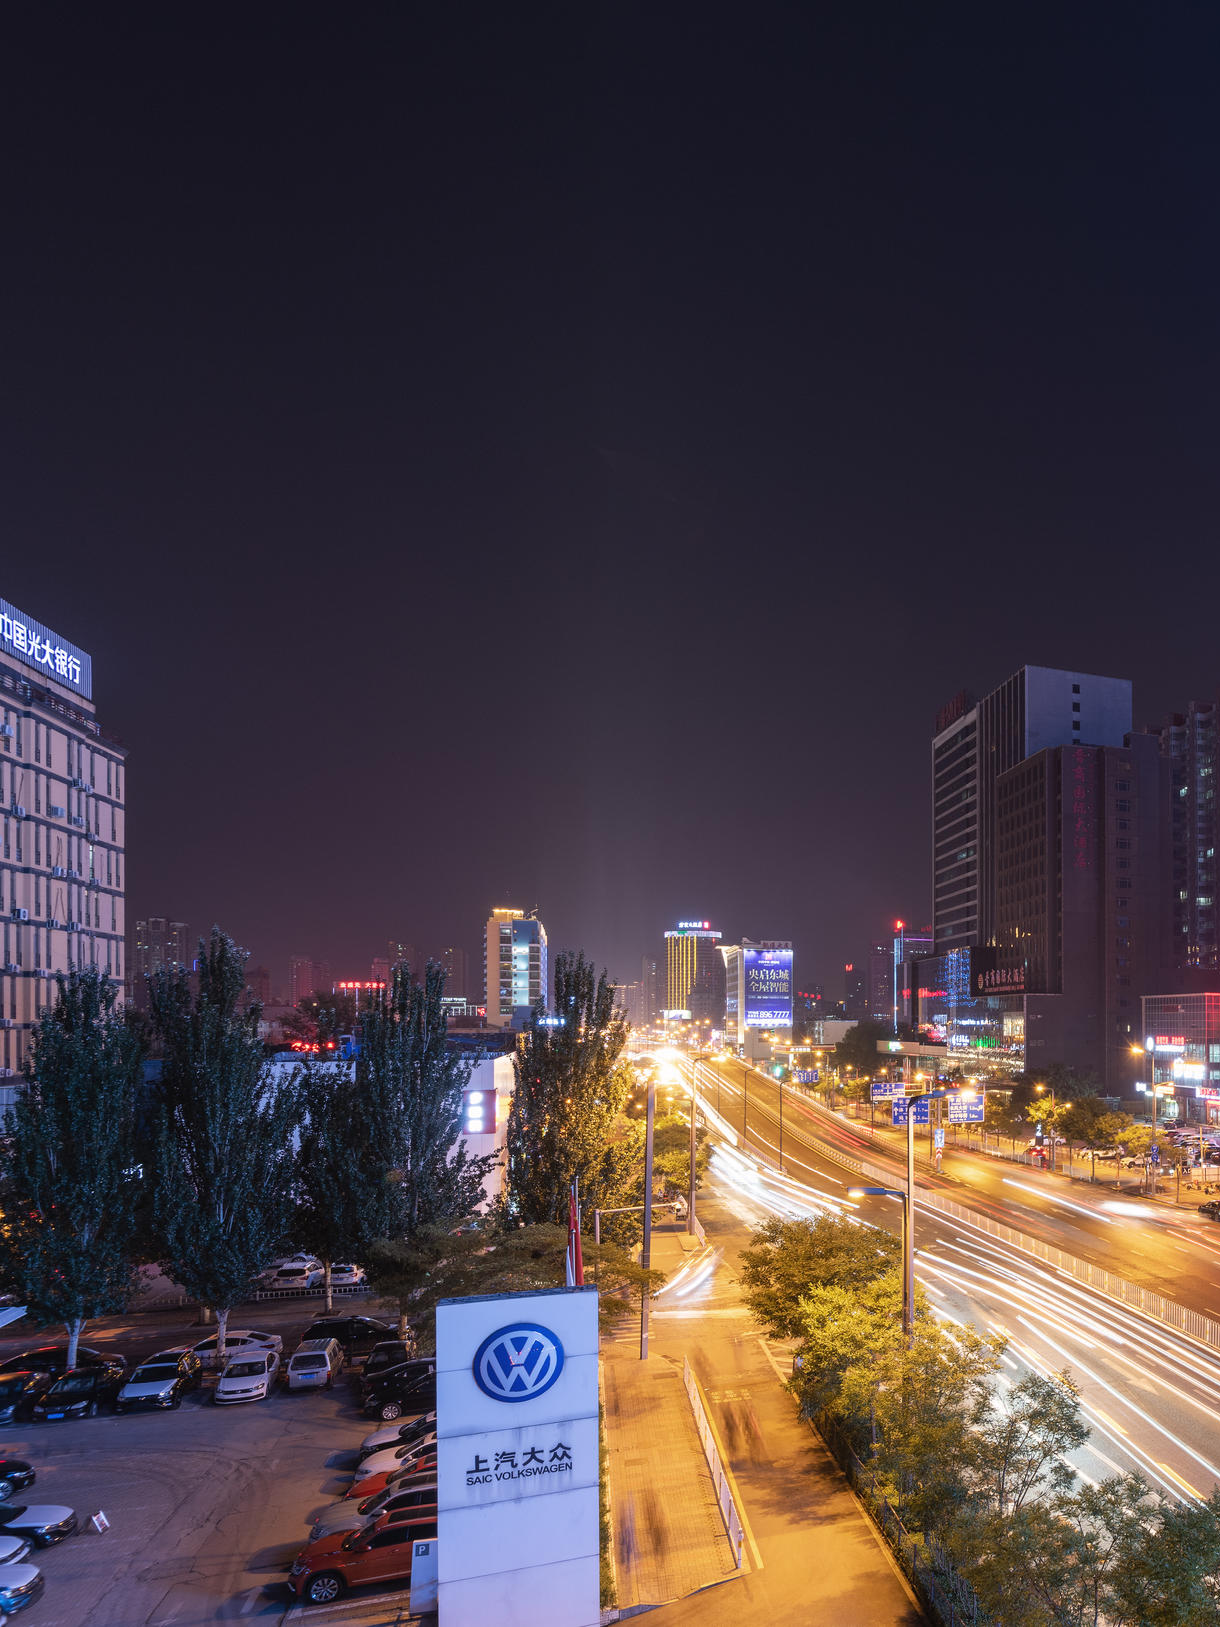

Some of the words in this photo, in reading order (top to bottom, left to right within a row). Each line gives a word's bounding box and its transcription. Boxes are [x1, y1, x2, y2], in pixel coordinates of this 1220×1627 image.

[0, 613, 80, 684] 中国光大银行
[749, 981, 789, 992] 全屋智能
[774, 1011, 790, 1019] 7777
[466, 1442, 572, 1474] 上汽大众
[466, 1473, 493, 1487] SAIC
[494, 1462, 573, 1482] VOLKSWAGEN
[418, 1545, 427, 1556] P
